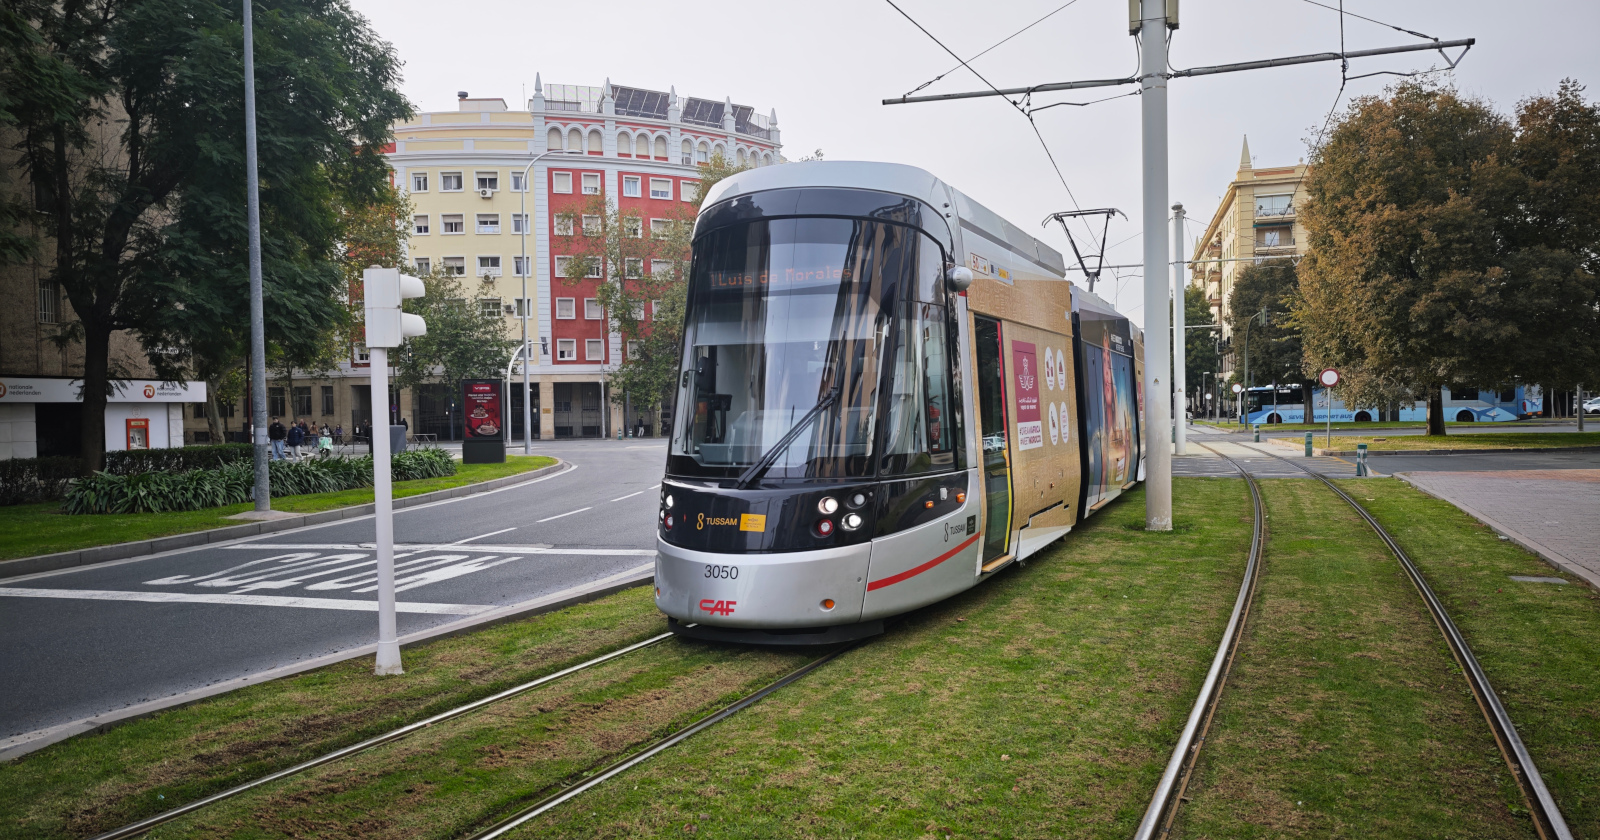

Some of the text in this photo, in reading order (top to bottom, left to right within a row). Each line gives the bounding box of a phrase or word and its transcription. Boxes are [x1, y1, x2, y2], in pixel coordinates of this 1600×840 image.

[760, 270, 778, 284] de
[785, 265, 852, 283] Morales
[706, 517, 737, 526] TUSSAM
[950, 523, 966, 535] TUSSAM
[704, 564, 739, 580] 3050
[699, 598, 737, 616] CAF
